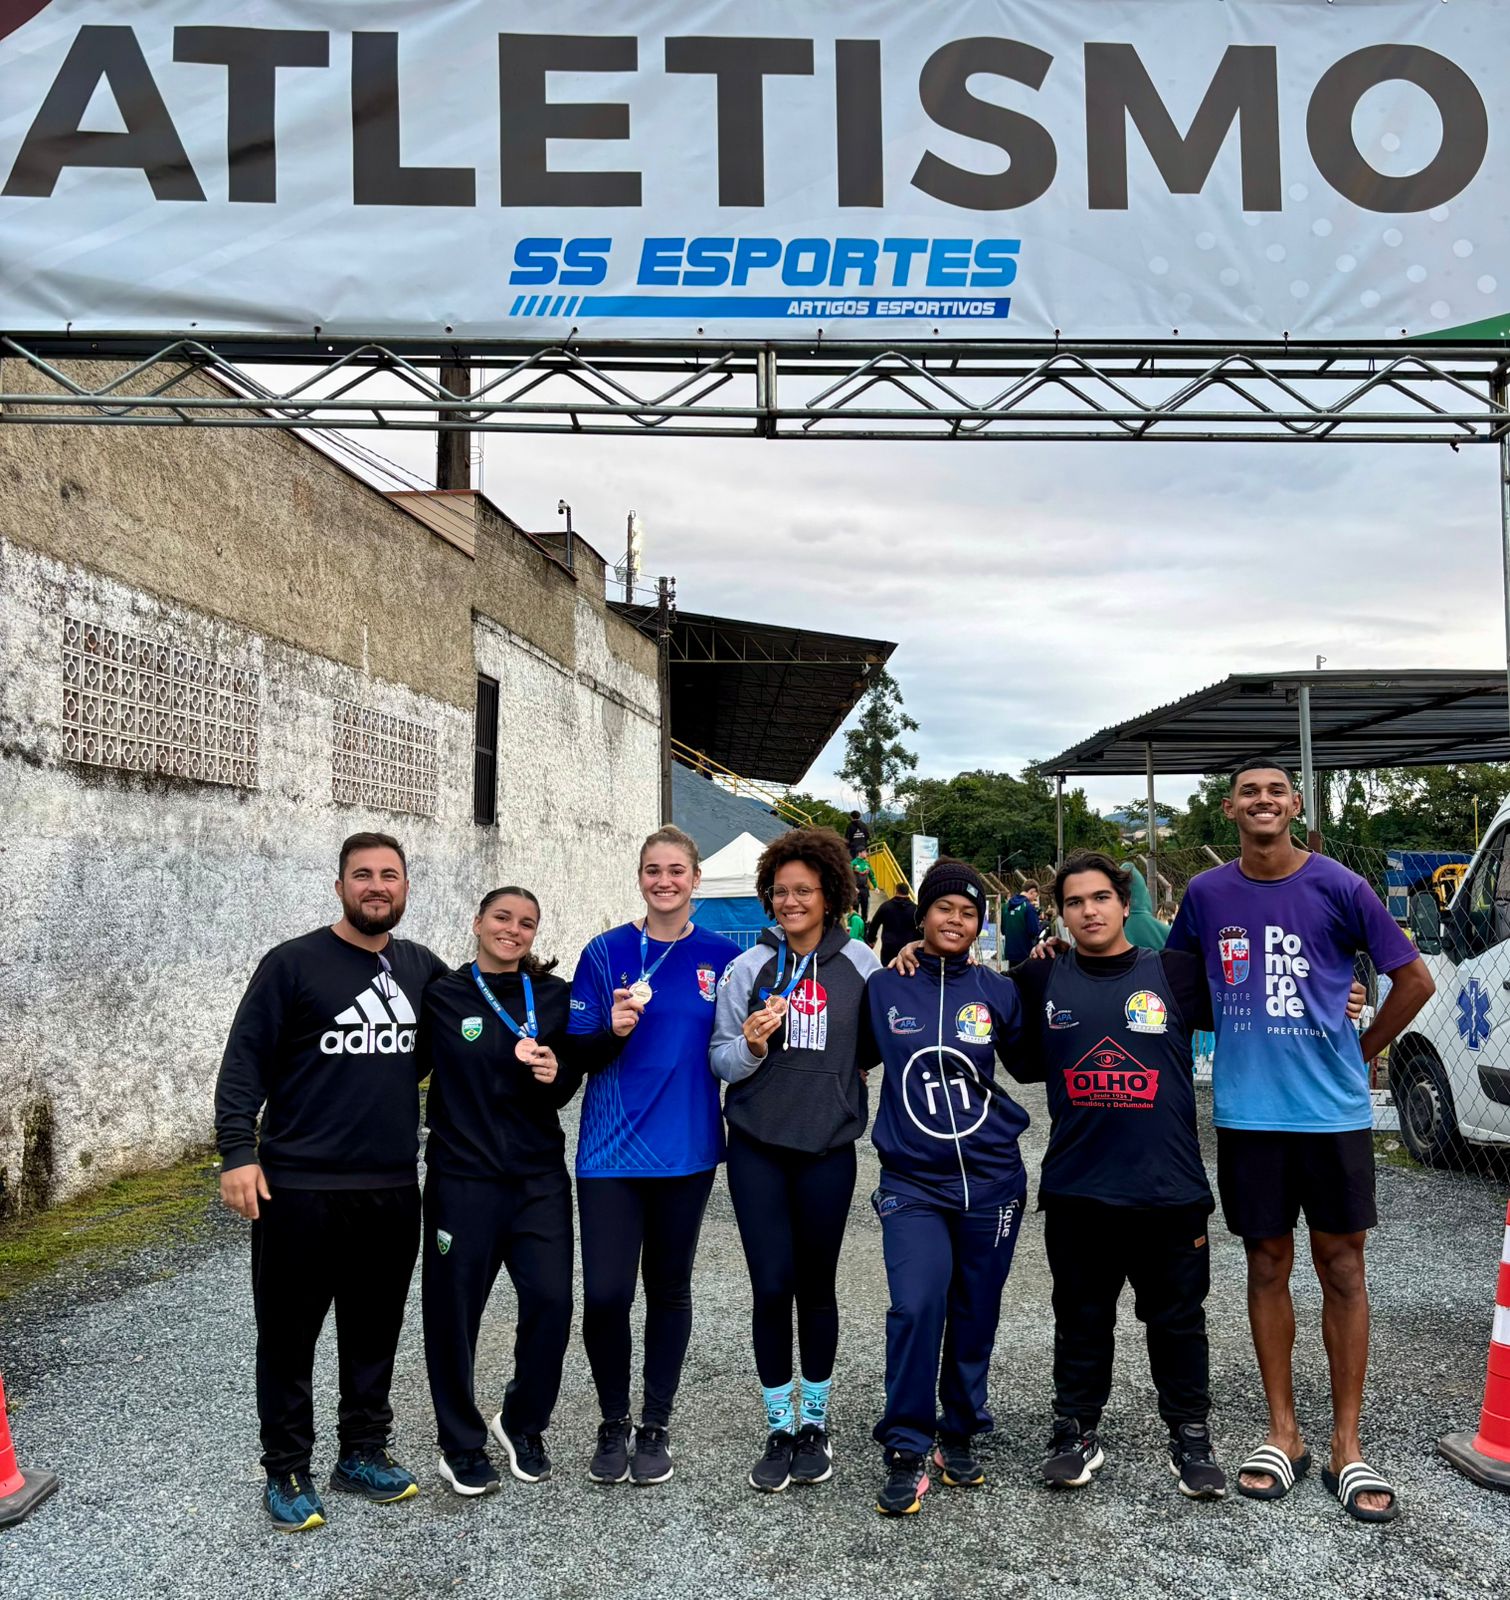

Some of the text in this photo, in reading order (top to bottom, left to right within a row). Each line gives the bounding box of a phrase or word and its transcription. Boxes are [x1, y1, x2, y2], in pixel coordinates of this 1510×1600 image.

[1, 25, 1489, 214] ATLETISMO
[509, 238, 1021, 287] SS ESPORTES
[786, 300, 996, 316] ARTIGOS ESPORTIVOS
[1223, 1005, 1252, 1016] Alles
[1233, 1022, 1252, 1032] gut
[1267, 1026, 1327, 1038] PREFEITURA
[1073, 1073, 1148, 1092] OLHO
